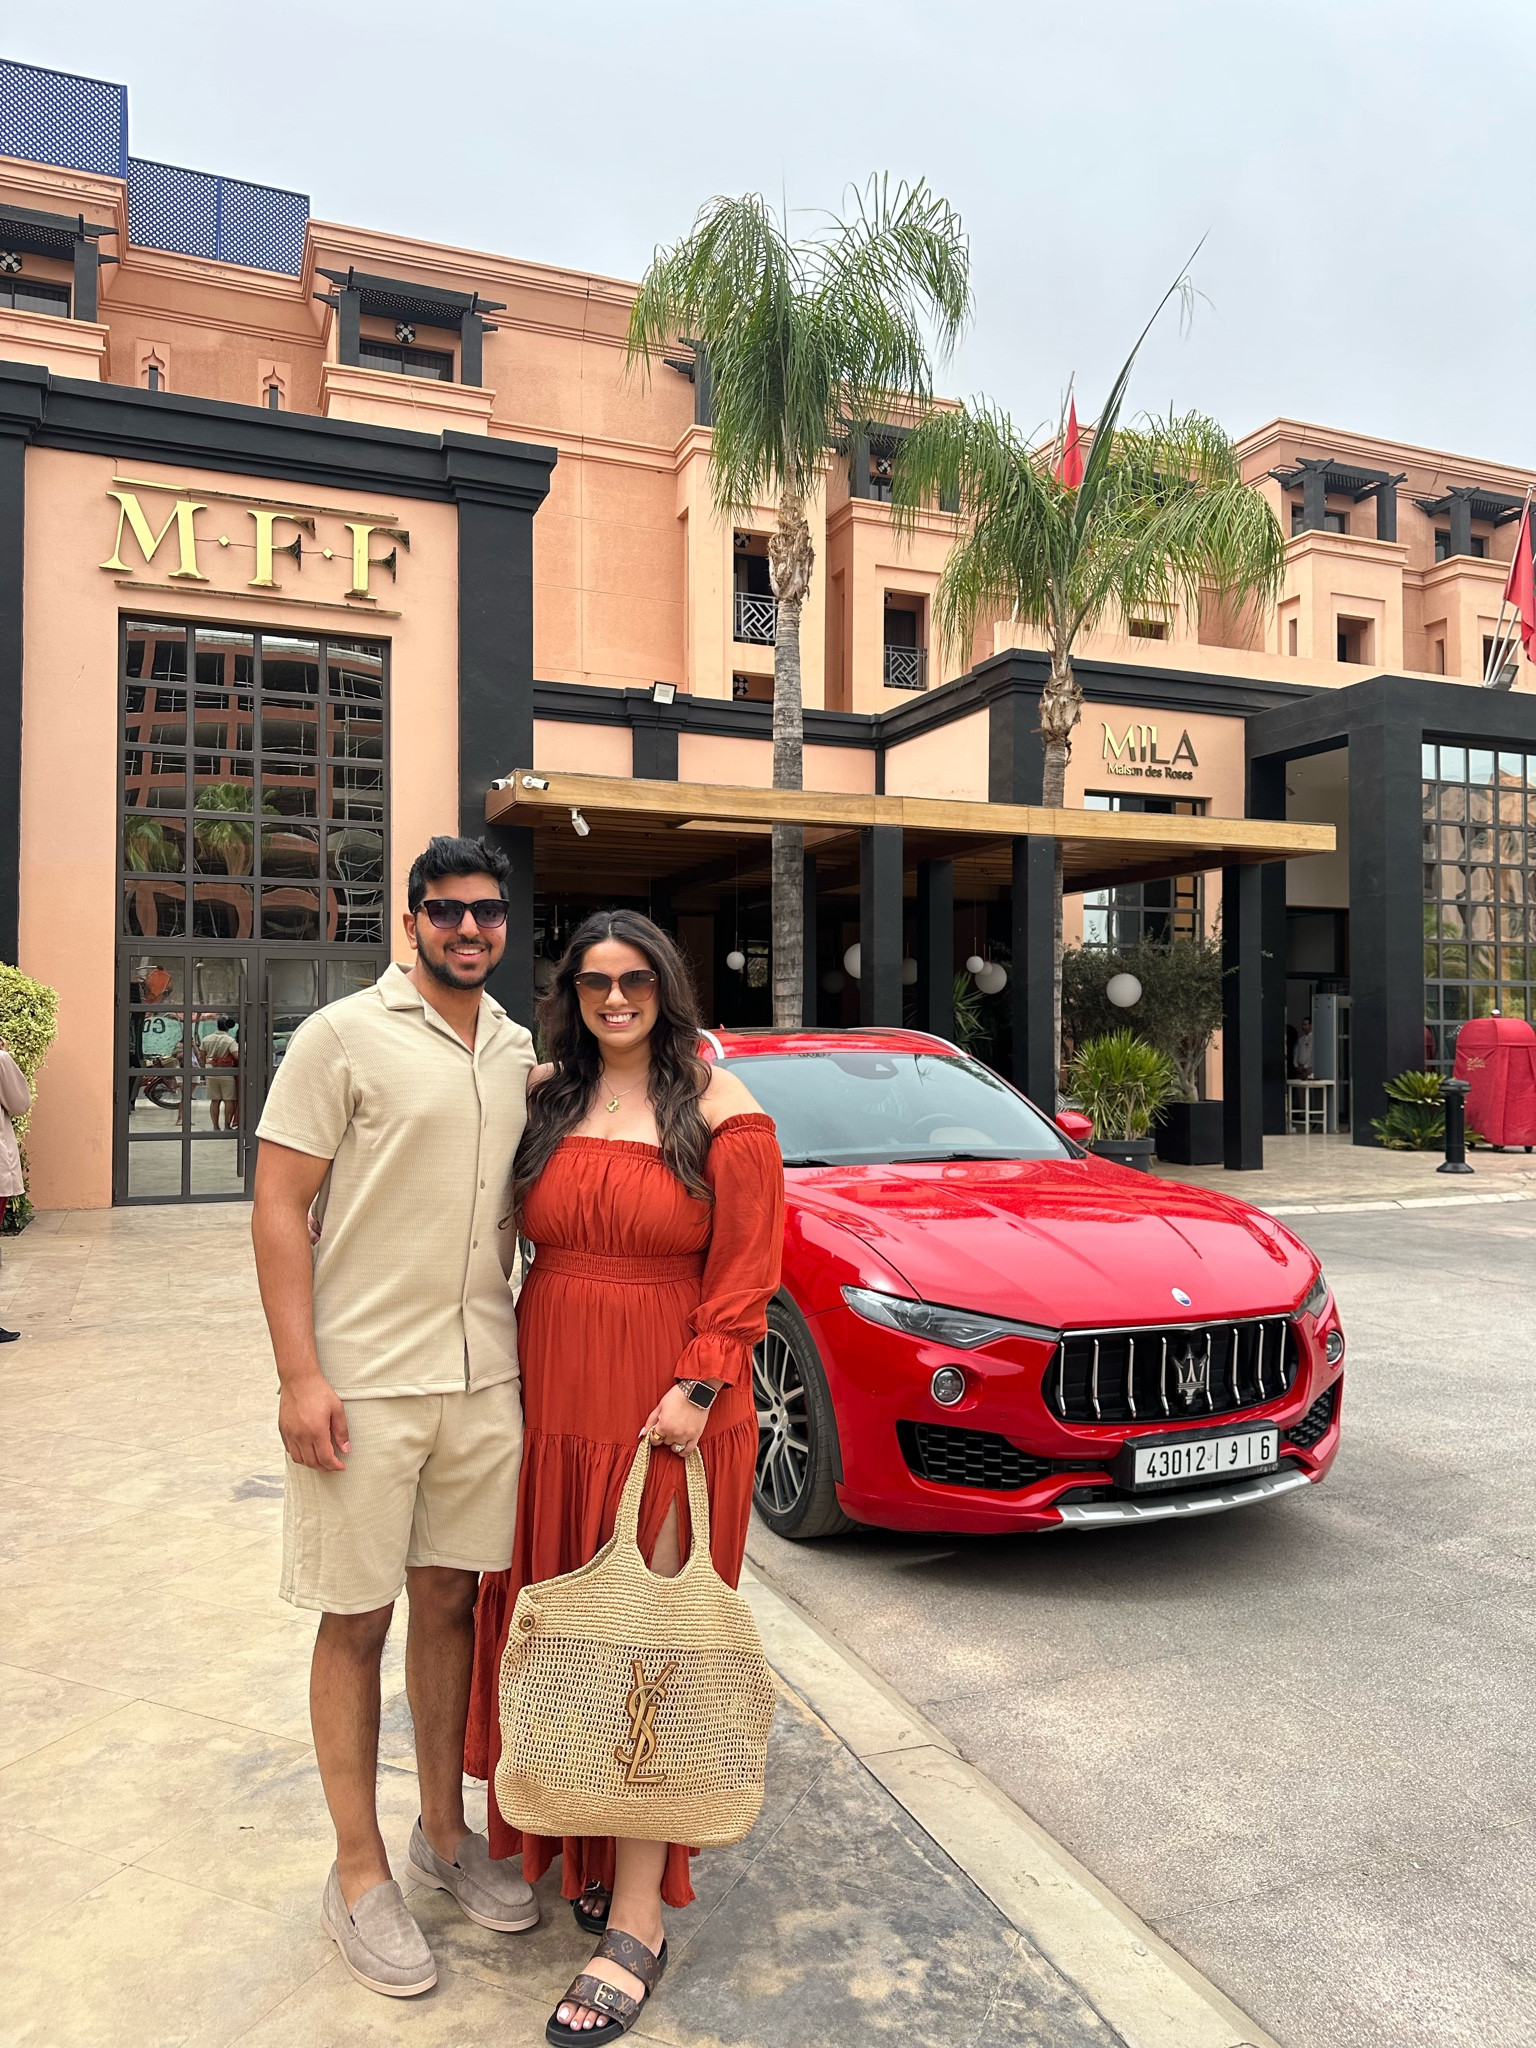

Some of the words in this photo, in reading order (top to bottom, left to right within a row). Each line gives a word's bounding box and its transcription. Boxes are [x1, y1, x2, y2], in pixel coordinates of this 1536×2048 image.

[1102, 722, 1199, 767] MILA
[1107, 762, 1143, 777] Maison
[1145, 765, 1162, 778] des
[1164, 767, 1193, 780] Roses
[1147, 1446, 1206, 1478] 43012
